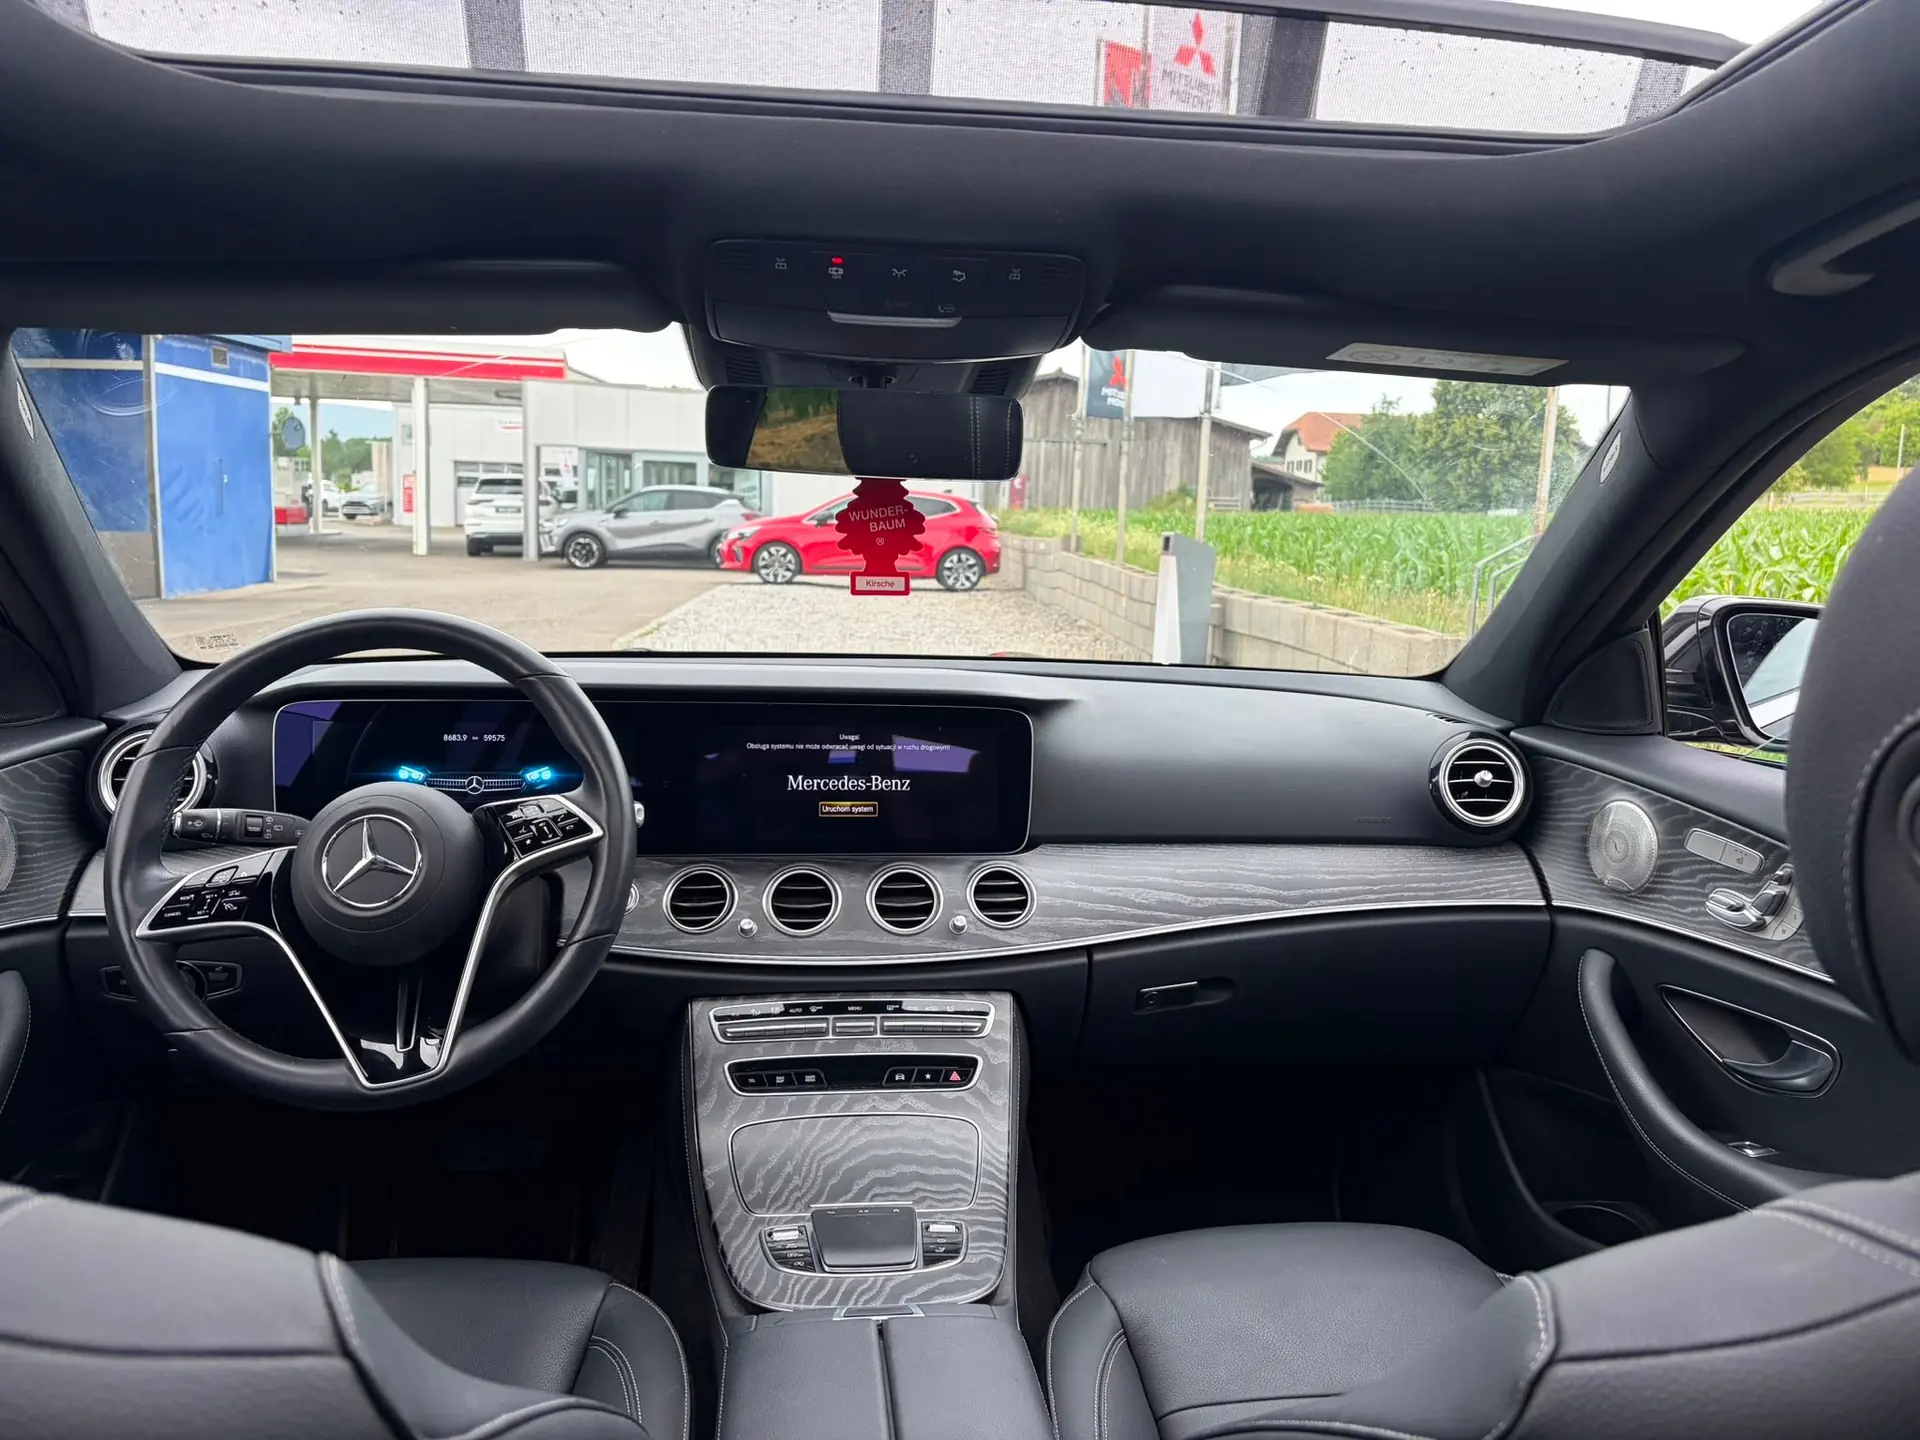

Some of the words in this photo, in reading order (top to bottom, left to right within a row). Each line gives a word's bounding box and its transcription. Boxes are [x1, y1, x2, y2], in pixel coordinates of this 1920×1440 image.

[848, 505, 908, 522] WUNDER-
[869, 518, 906, 532] BAUM
[865, 579, 895, 588] Kirsche
[443, 734, 468, 742] 8683.9
[483, 734, 506, 742] 59575
[839, 733, 860, 741] Uwaga!
[787, 774, 911, 791] Mercedes-Benz
[821, 804, 851, 812] Uruchom
[851, 806, 874, 814] system
